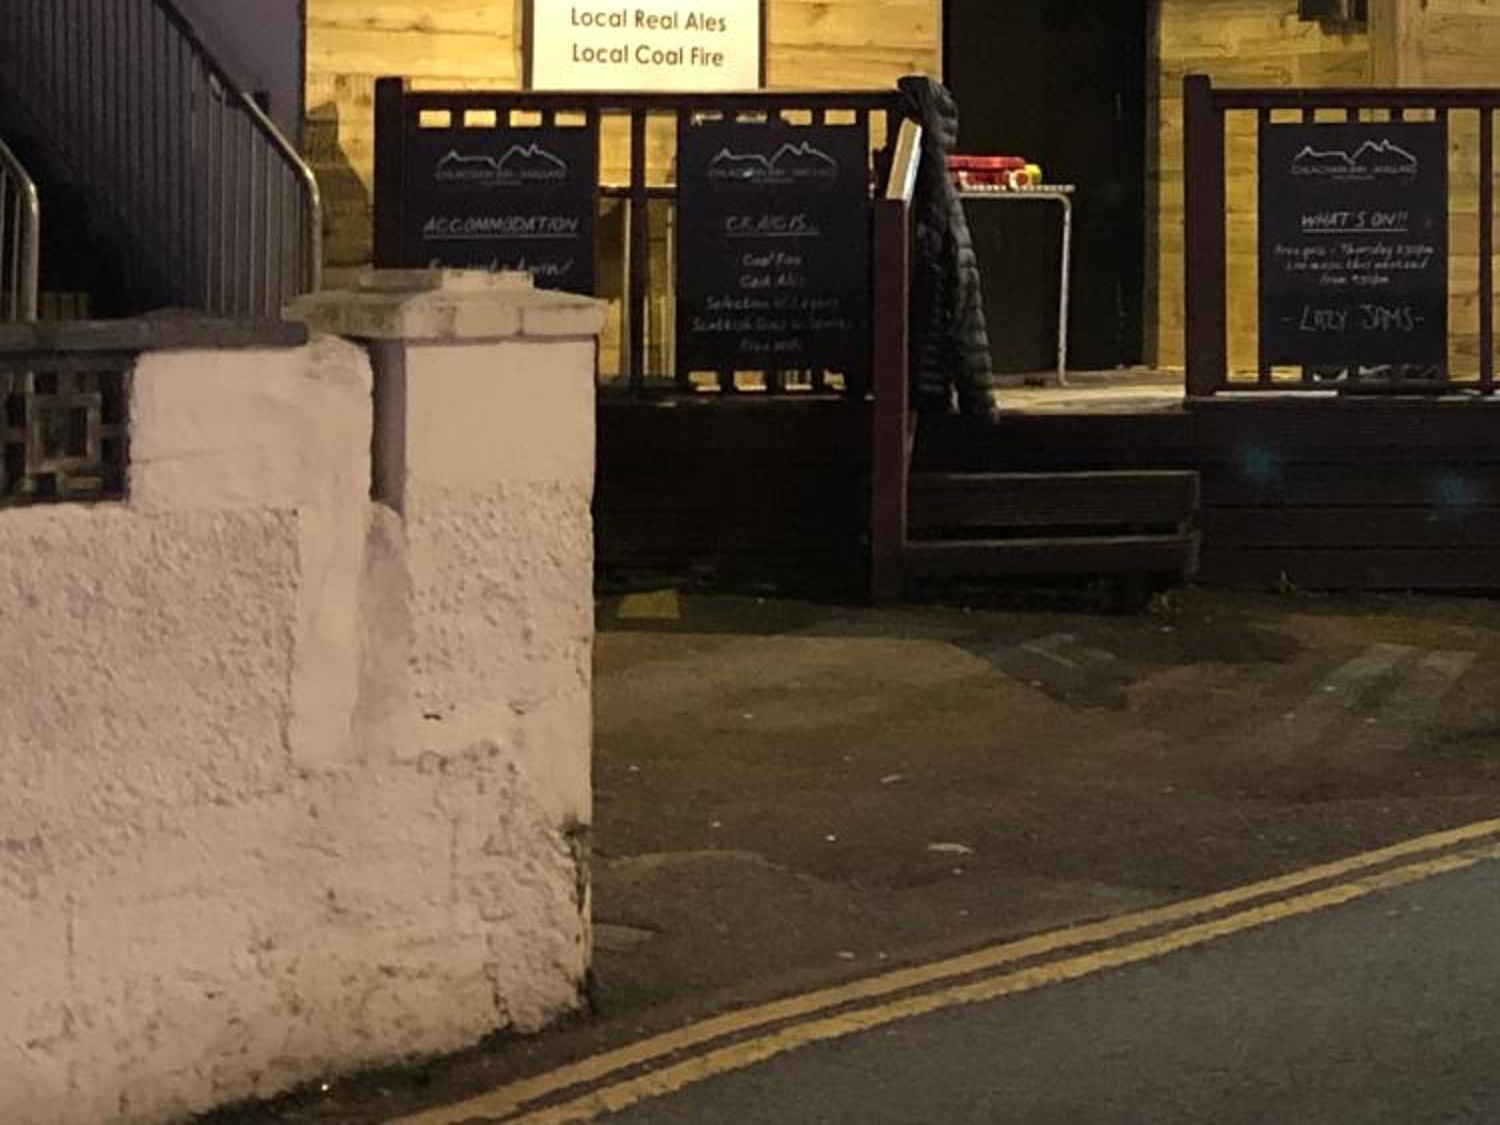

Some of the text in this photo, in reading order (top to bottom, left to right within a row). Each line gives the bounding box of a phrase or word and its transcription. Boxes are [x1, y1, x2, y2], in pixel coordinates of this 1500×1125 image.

[571, 7, 727, 34] Local Real Ales
[572, 42, 724, 68] Local Coal Fire
[423, 215, 579, 233] ACCOMMODATION
